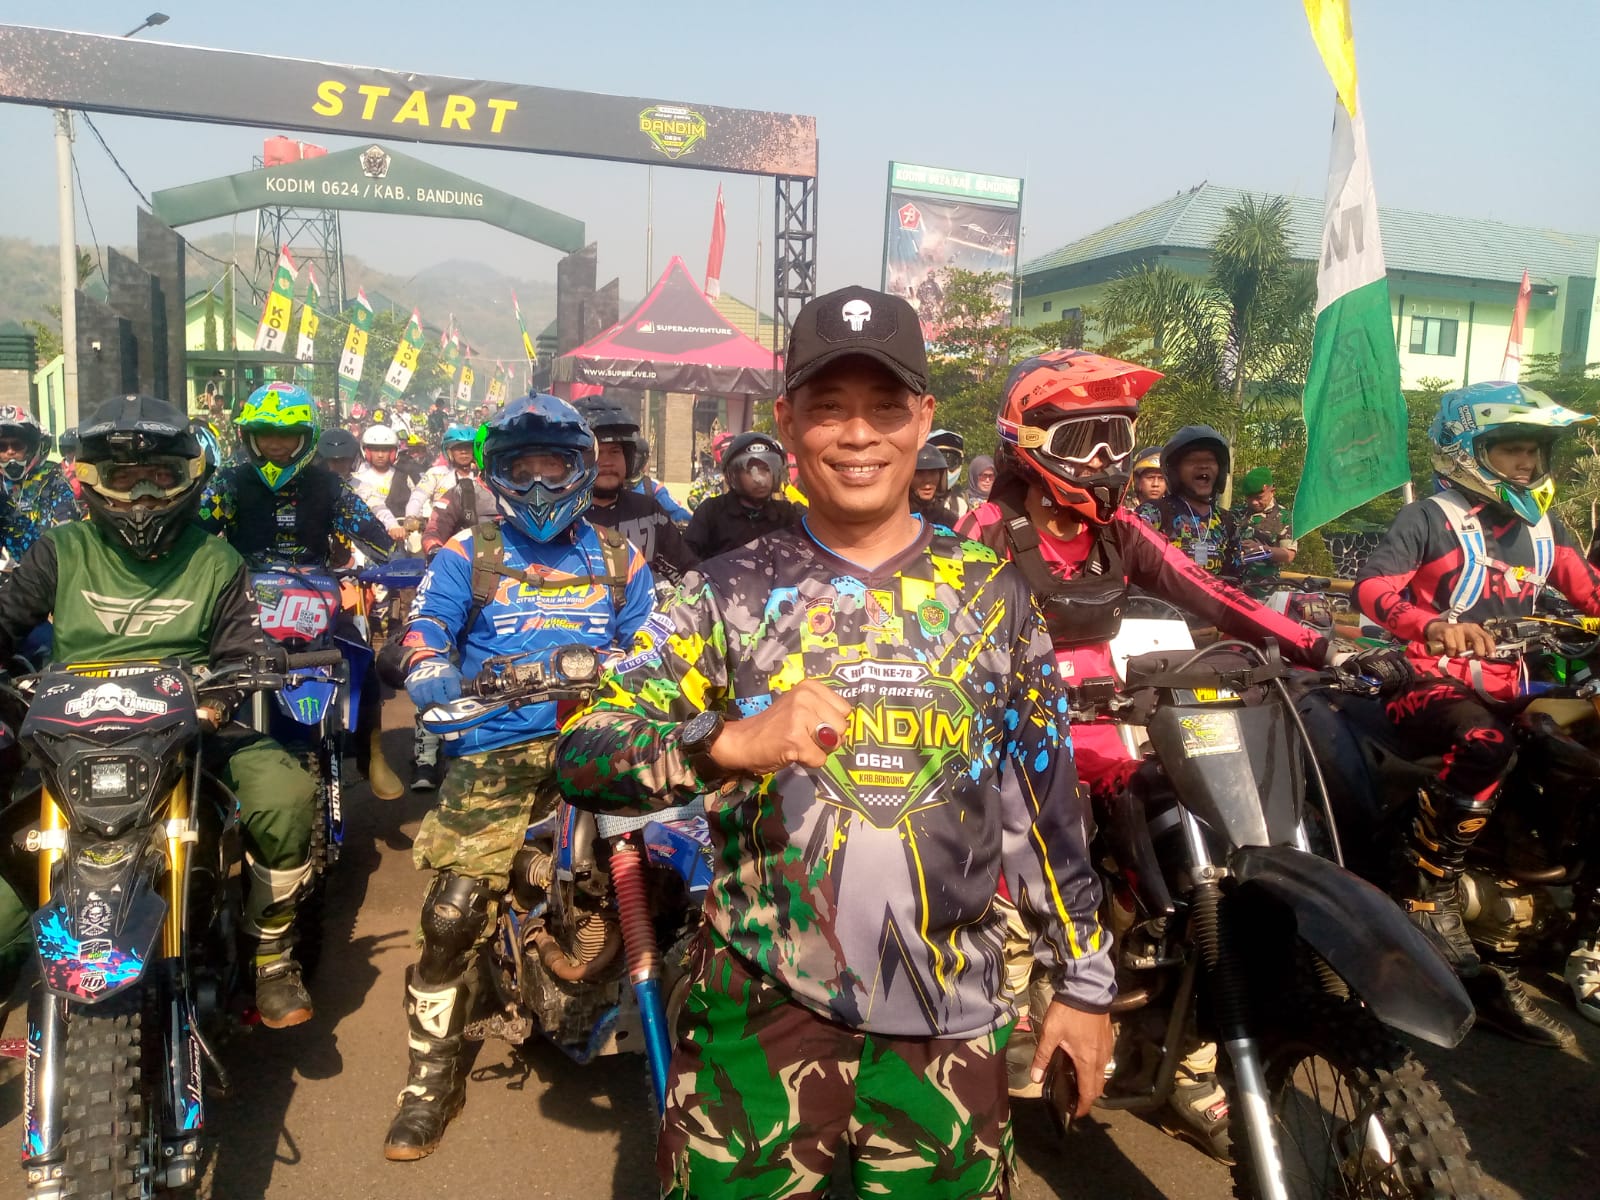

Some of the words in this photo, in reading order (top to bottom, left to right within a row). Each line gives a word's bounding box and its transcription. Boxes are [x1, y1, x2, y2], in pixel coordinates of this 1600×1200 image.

[312, 80, 518, 133] START
[640, 118, 706, 140] DANDIM
[266, 177, 316, 193] KODIM
[321, 180, 359, 197] 0624
[373, 184, 411, 201] KAB.
[416, 187, 484, 206] BANDUNG
[265, 305, 284, 350] KODI
[655, 324, 733, 335] SUPERADVENTURE
[583, 367, 657, 379] WWW.SUPERLIVE.ID
[883, 668, 913, 679] KE-78
[880, 686, 934, 699] BARENG
[67, 699, 93, 715] FIRST
[124, 699, 166, 714] FAMOUS
[844, 703, 971, 757] ANDIM
[855, 753, 904, 769] 0624
[859, 773, 905, 785] KAB.BANDUNG
[330, 753, 341, 822] DUNLOP
